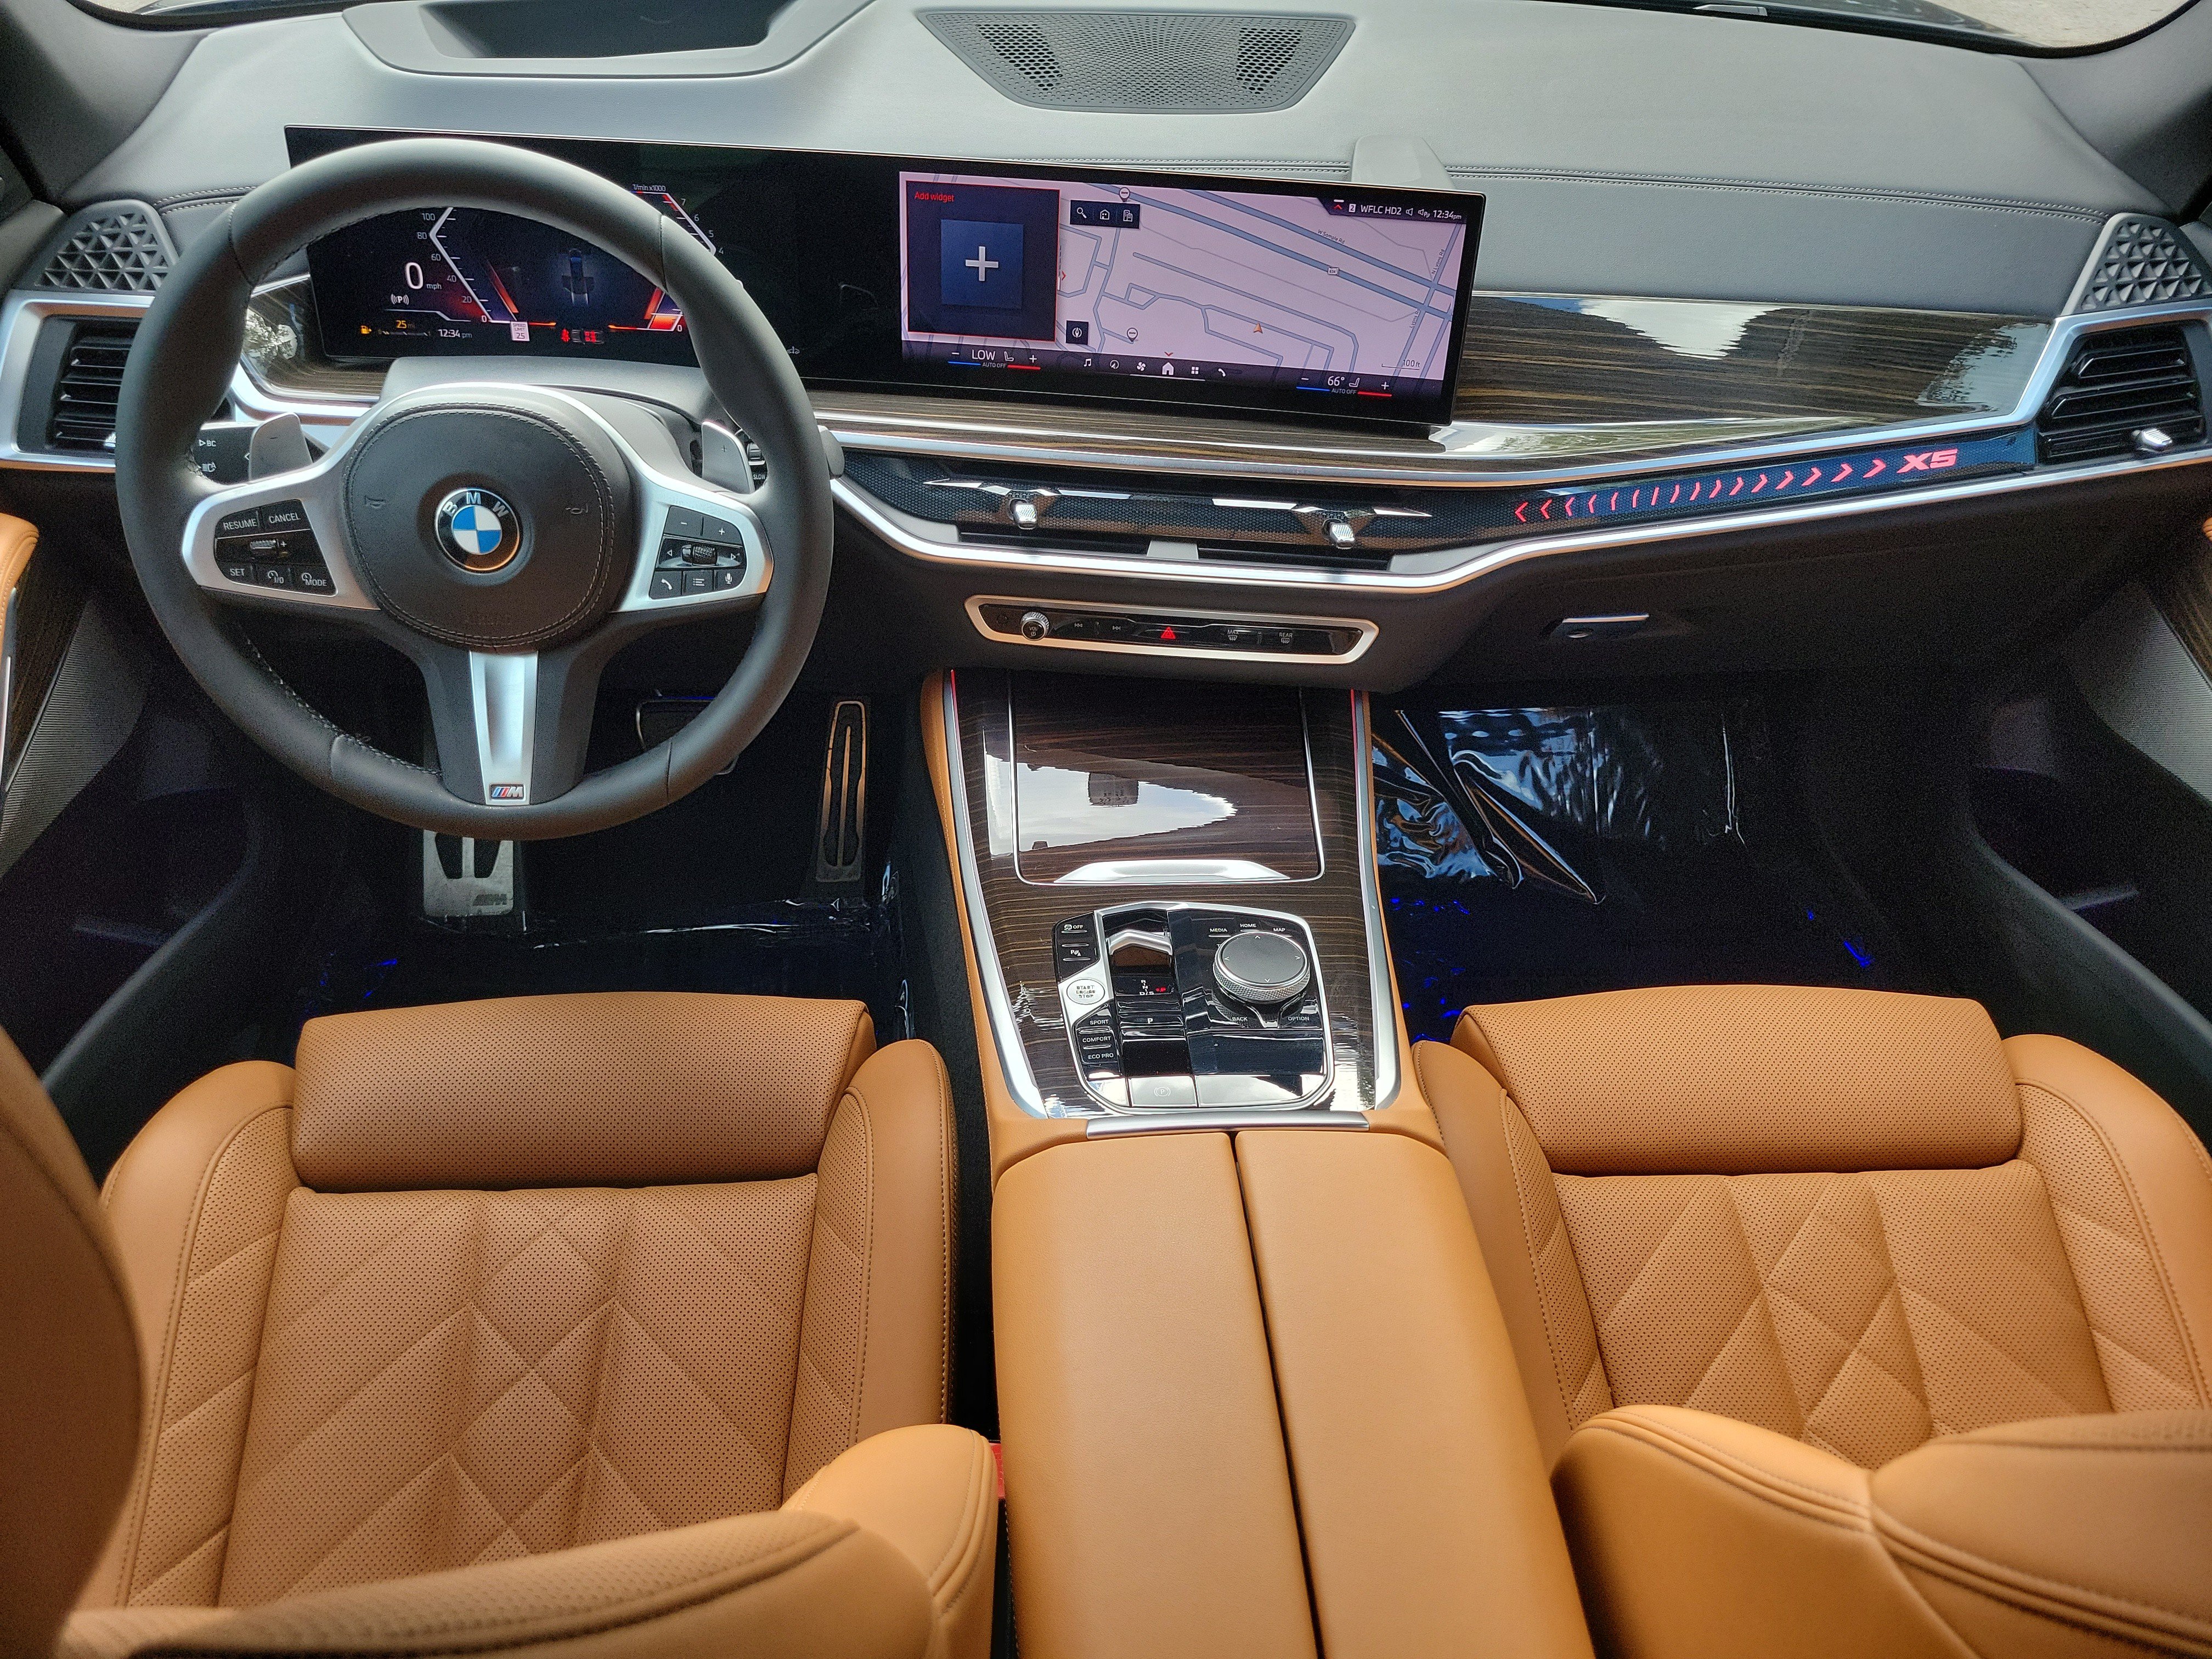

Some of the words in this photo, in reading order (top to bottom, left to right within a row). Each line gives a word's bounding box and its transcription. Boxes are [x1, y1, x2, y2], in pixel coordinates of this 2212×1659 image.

[914, 191, 929, 200] Add
[930, 193, 955, 203] widget
[1361, 205, 1384, 214] WFLC
[1385, 207, 1402, 215] HD2
[404, 262, 424, 290] 0
[426, 283, 442, 291] mph
[396, 320, 407, 329] 25
[972, 349, 996, 360] LOW
[1896, 449, 1958, 473] X5
[442, 492, 509, 517] BMW
[269, 512, 301, 524] CANCEL
[223, 518, 258, 531] RESUME
[229, 568, 245, 577] SET
